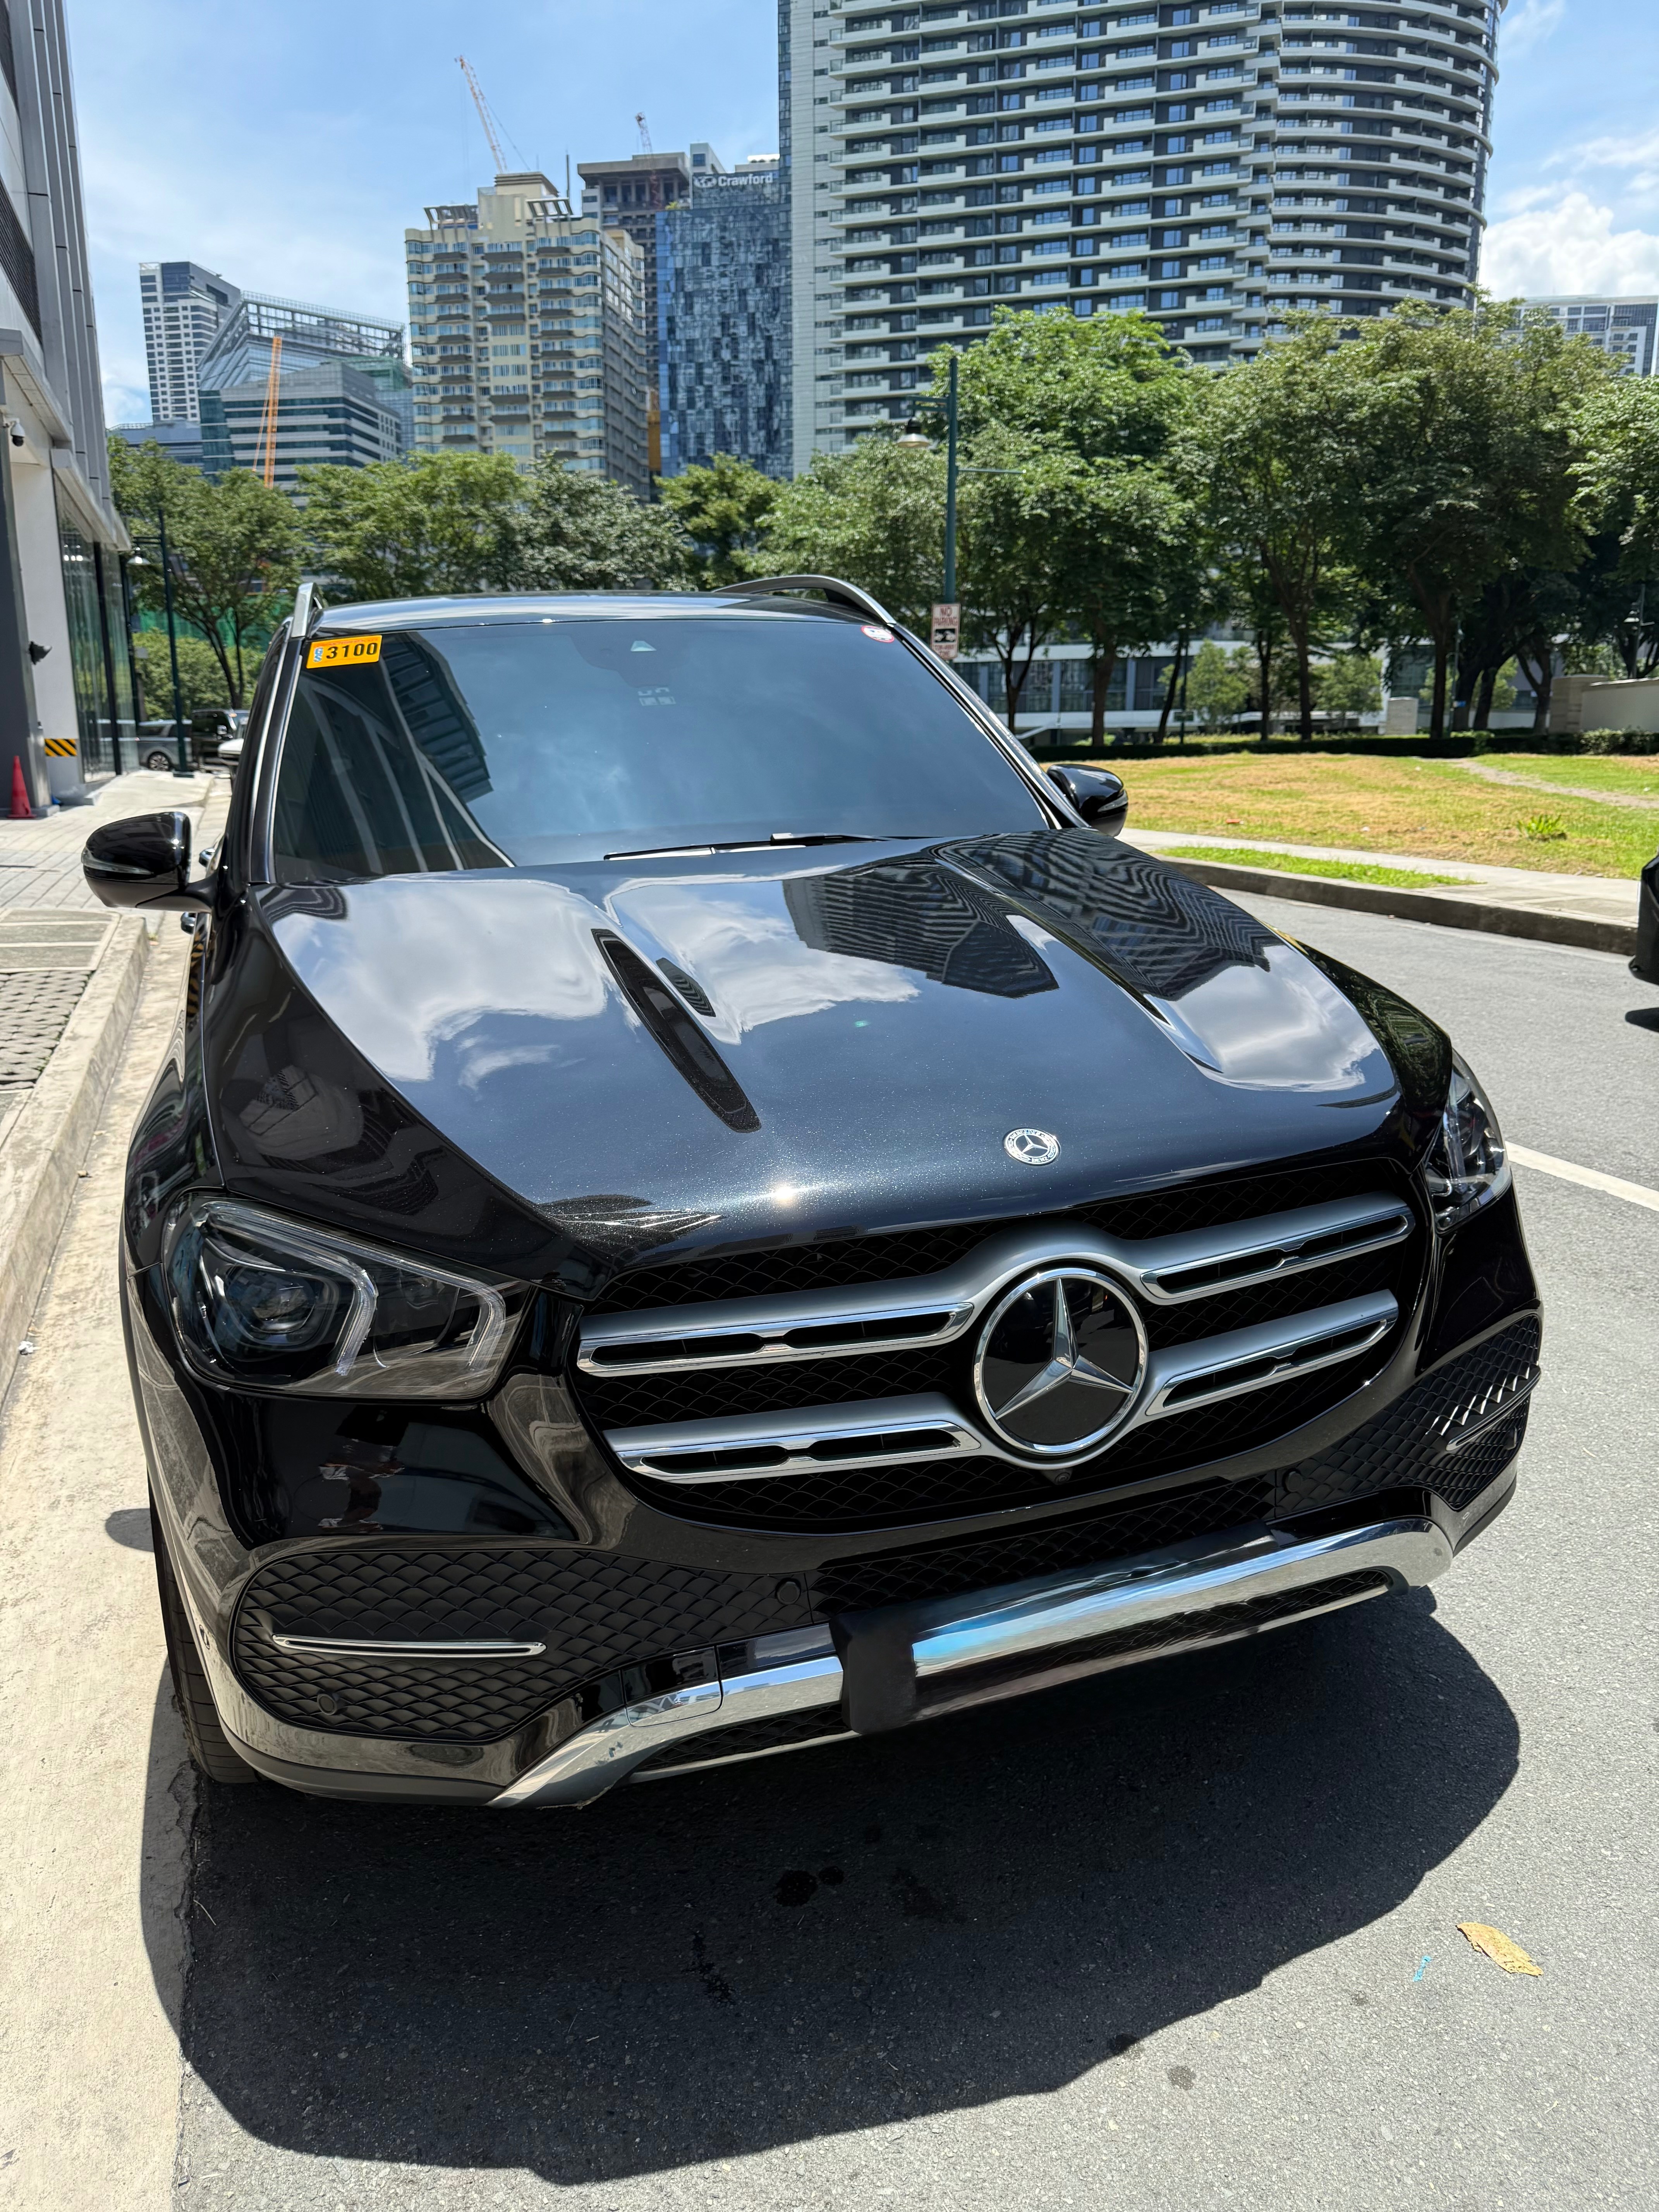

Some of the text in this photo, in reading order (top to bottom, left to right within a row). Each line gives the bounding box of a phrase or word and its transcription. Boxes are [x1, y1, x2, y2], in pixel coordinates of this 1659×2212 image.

[718, 173, 773, 187] Crawford
[940, 607, 952, 617] NO
[326, 642, 378, 659] 3100
